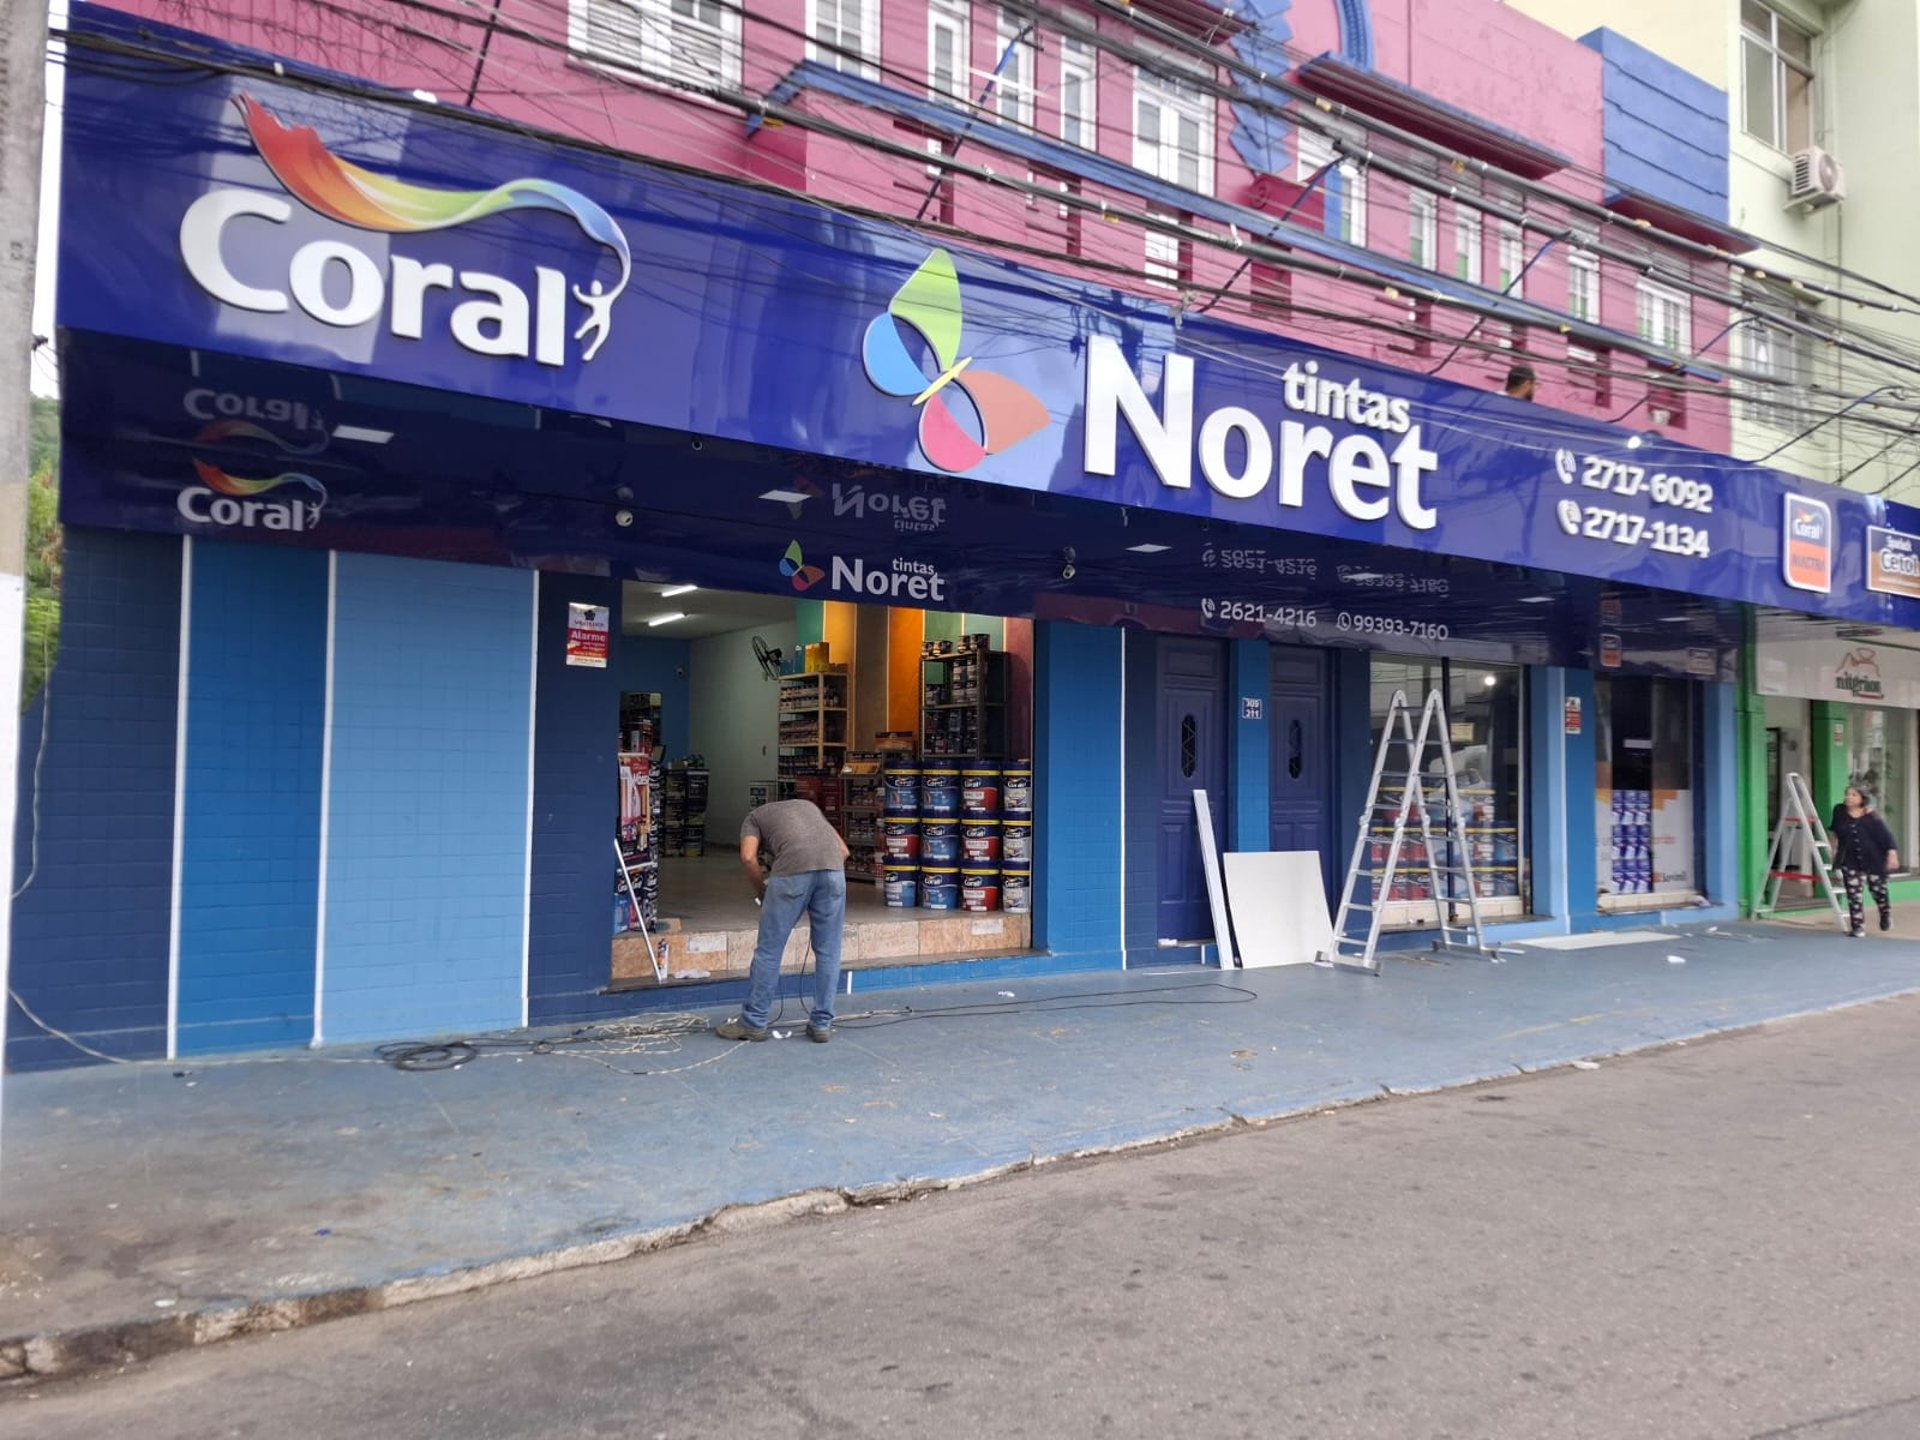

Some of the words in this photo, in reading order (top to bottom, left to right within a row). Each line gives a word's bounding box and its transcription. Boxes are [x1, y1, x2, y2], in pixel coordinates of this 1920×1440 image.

[180, 188, 567, 366] Coral
[1283, 360, 1410, 433] tintas
[1084, 335, 1439, 530] Noret
[1581, 456, 1714, 514] 2717-6092
[177, 486, 304, 531] Coral
[1793, 518, 1822, 539] Coral
[1582, 507, 1710, 559] 2717-1134
[832, 555, 945, 601] Noret
[893, 557, 935, 575] tintas
[571, 630, 606, 643] Alarme
[1220, 601, 1317, 628] 2621-4216
[1353, 615, 1449, 641] 99393-7160
